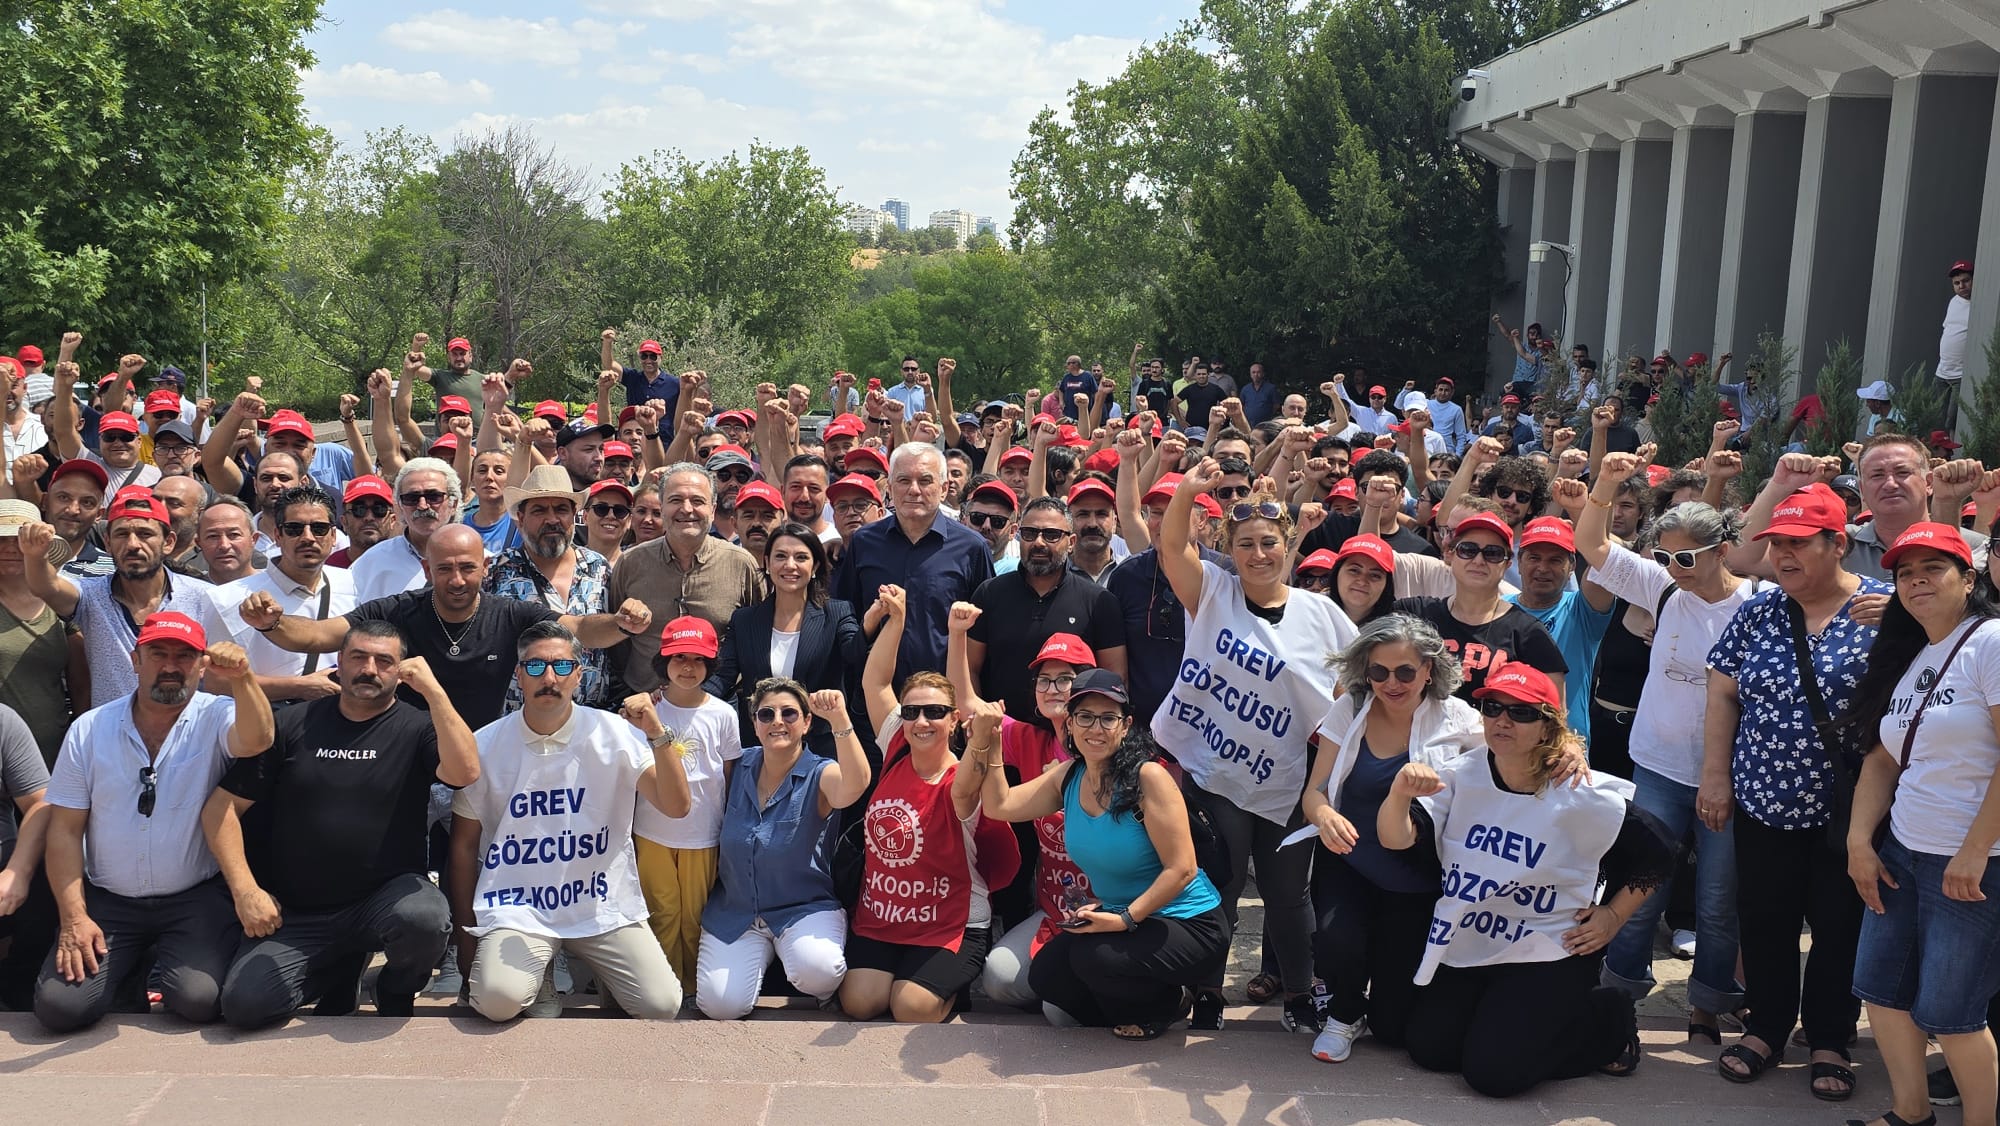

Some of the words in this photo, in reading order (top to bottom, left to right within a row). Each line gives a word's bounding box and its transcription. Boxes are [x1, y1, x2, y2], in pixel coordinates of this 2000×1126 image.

[1216, 628, 1286, 682] GREV
[1180, 658, 1292, 739] GÖZCÜSÜ
[316, 748, 377, 760] MONCLER
[1168, 694, 1275, 784] TEZ-KOOP-İŞ
[510, 788, 585, 818] GREV
[485, 826, 609, 869] GÖZCÜSÜ
[1465, 823, 1547, 869] GREV
[483, 871, 609, 911] TEZ-KOOP-İŞ
[866, 870, 950, 899] -KOOP-İŞ
[863, 889, 938, 923] EDİKASI
